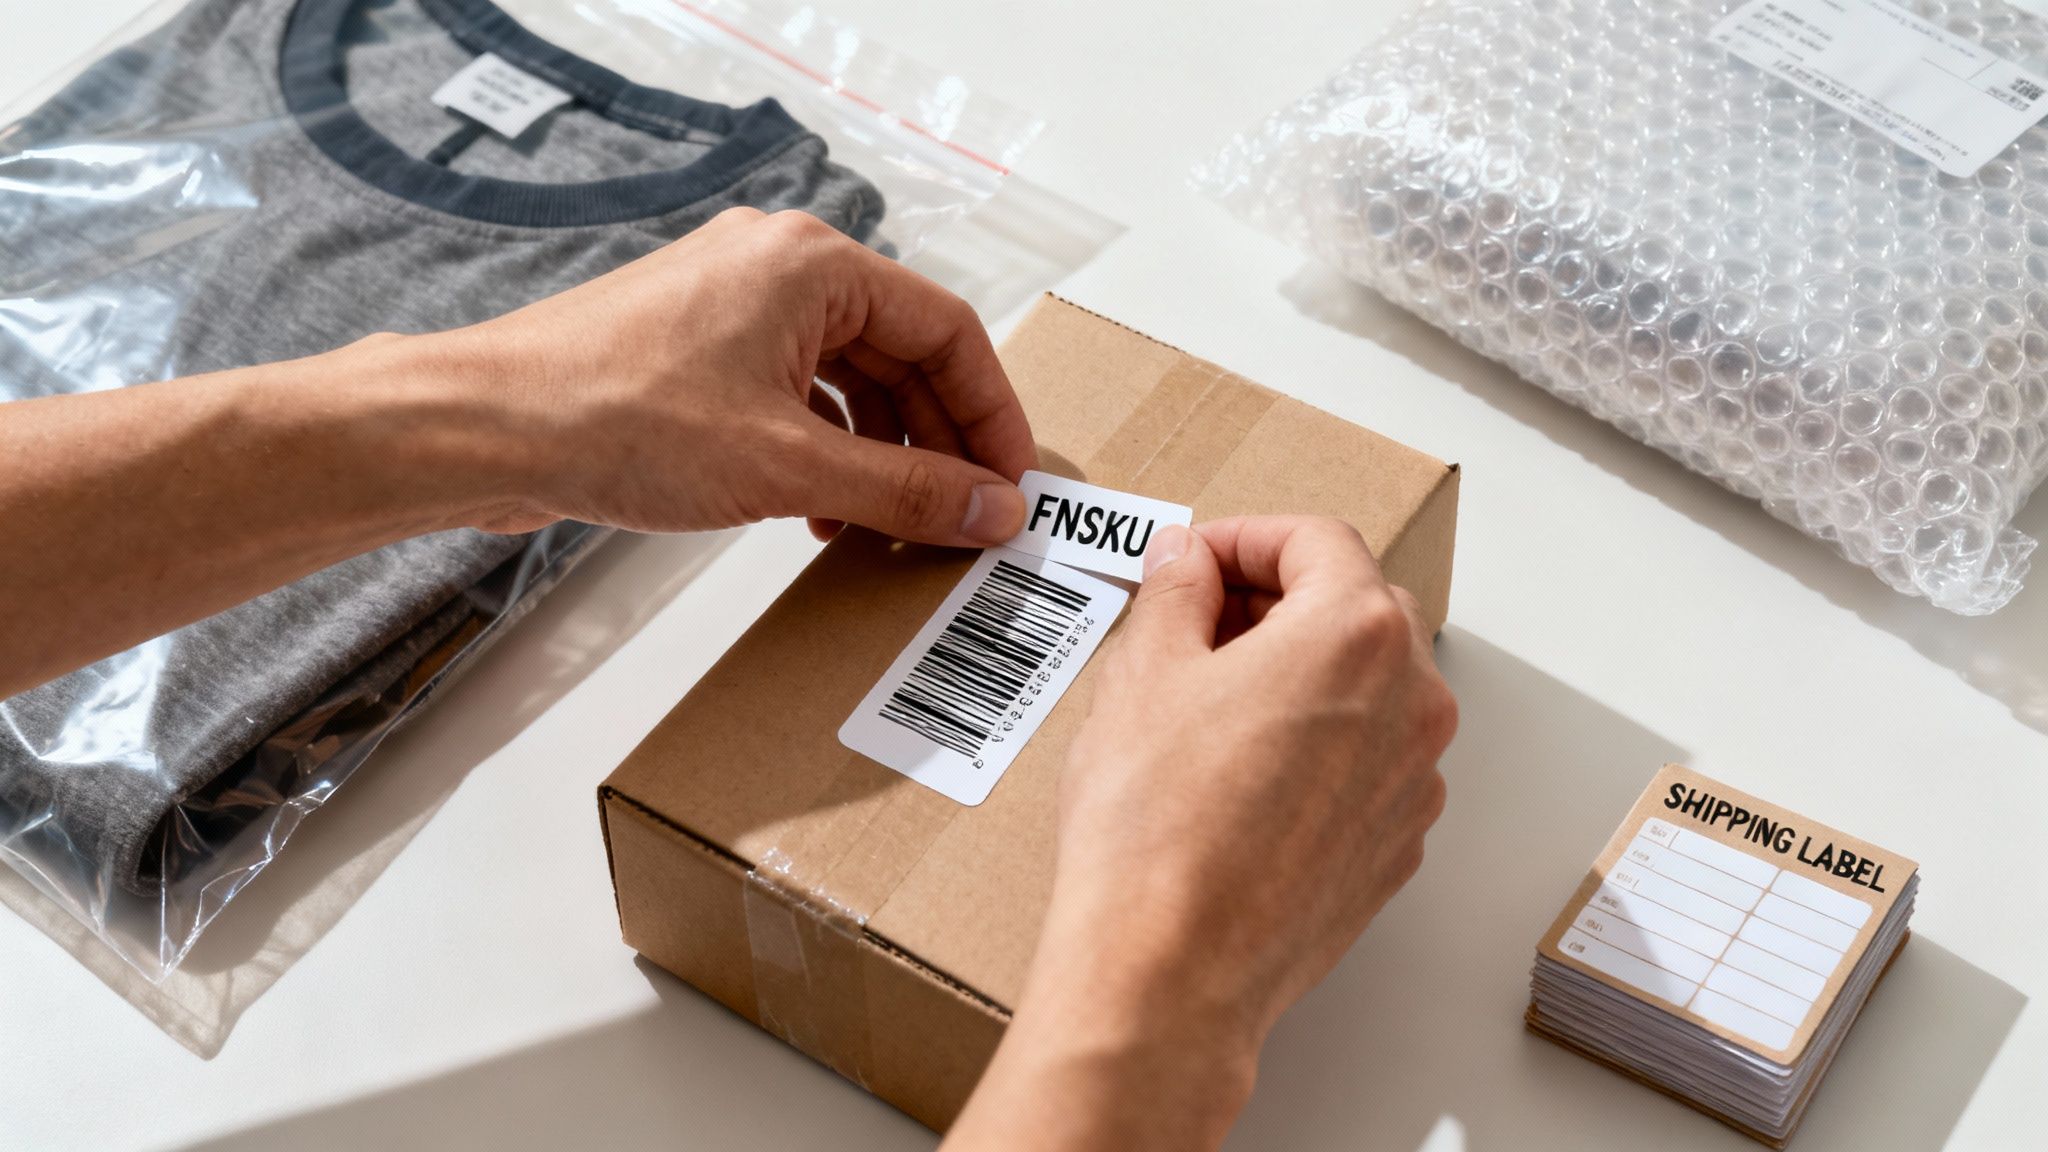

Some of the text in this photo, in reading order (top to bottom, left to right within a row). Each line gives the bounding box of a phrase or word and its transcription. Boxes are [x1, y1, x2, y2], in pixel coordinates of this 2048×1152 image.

[1028, 493, 1155, 558] FNSKU
[1663, 782, 1886, 894] SHIPPING LABEL
